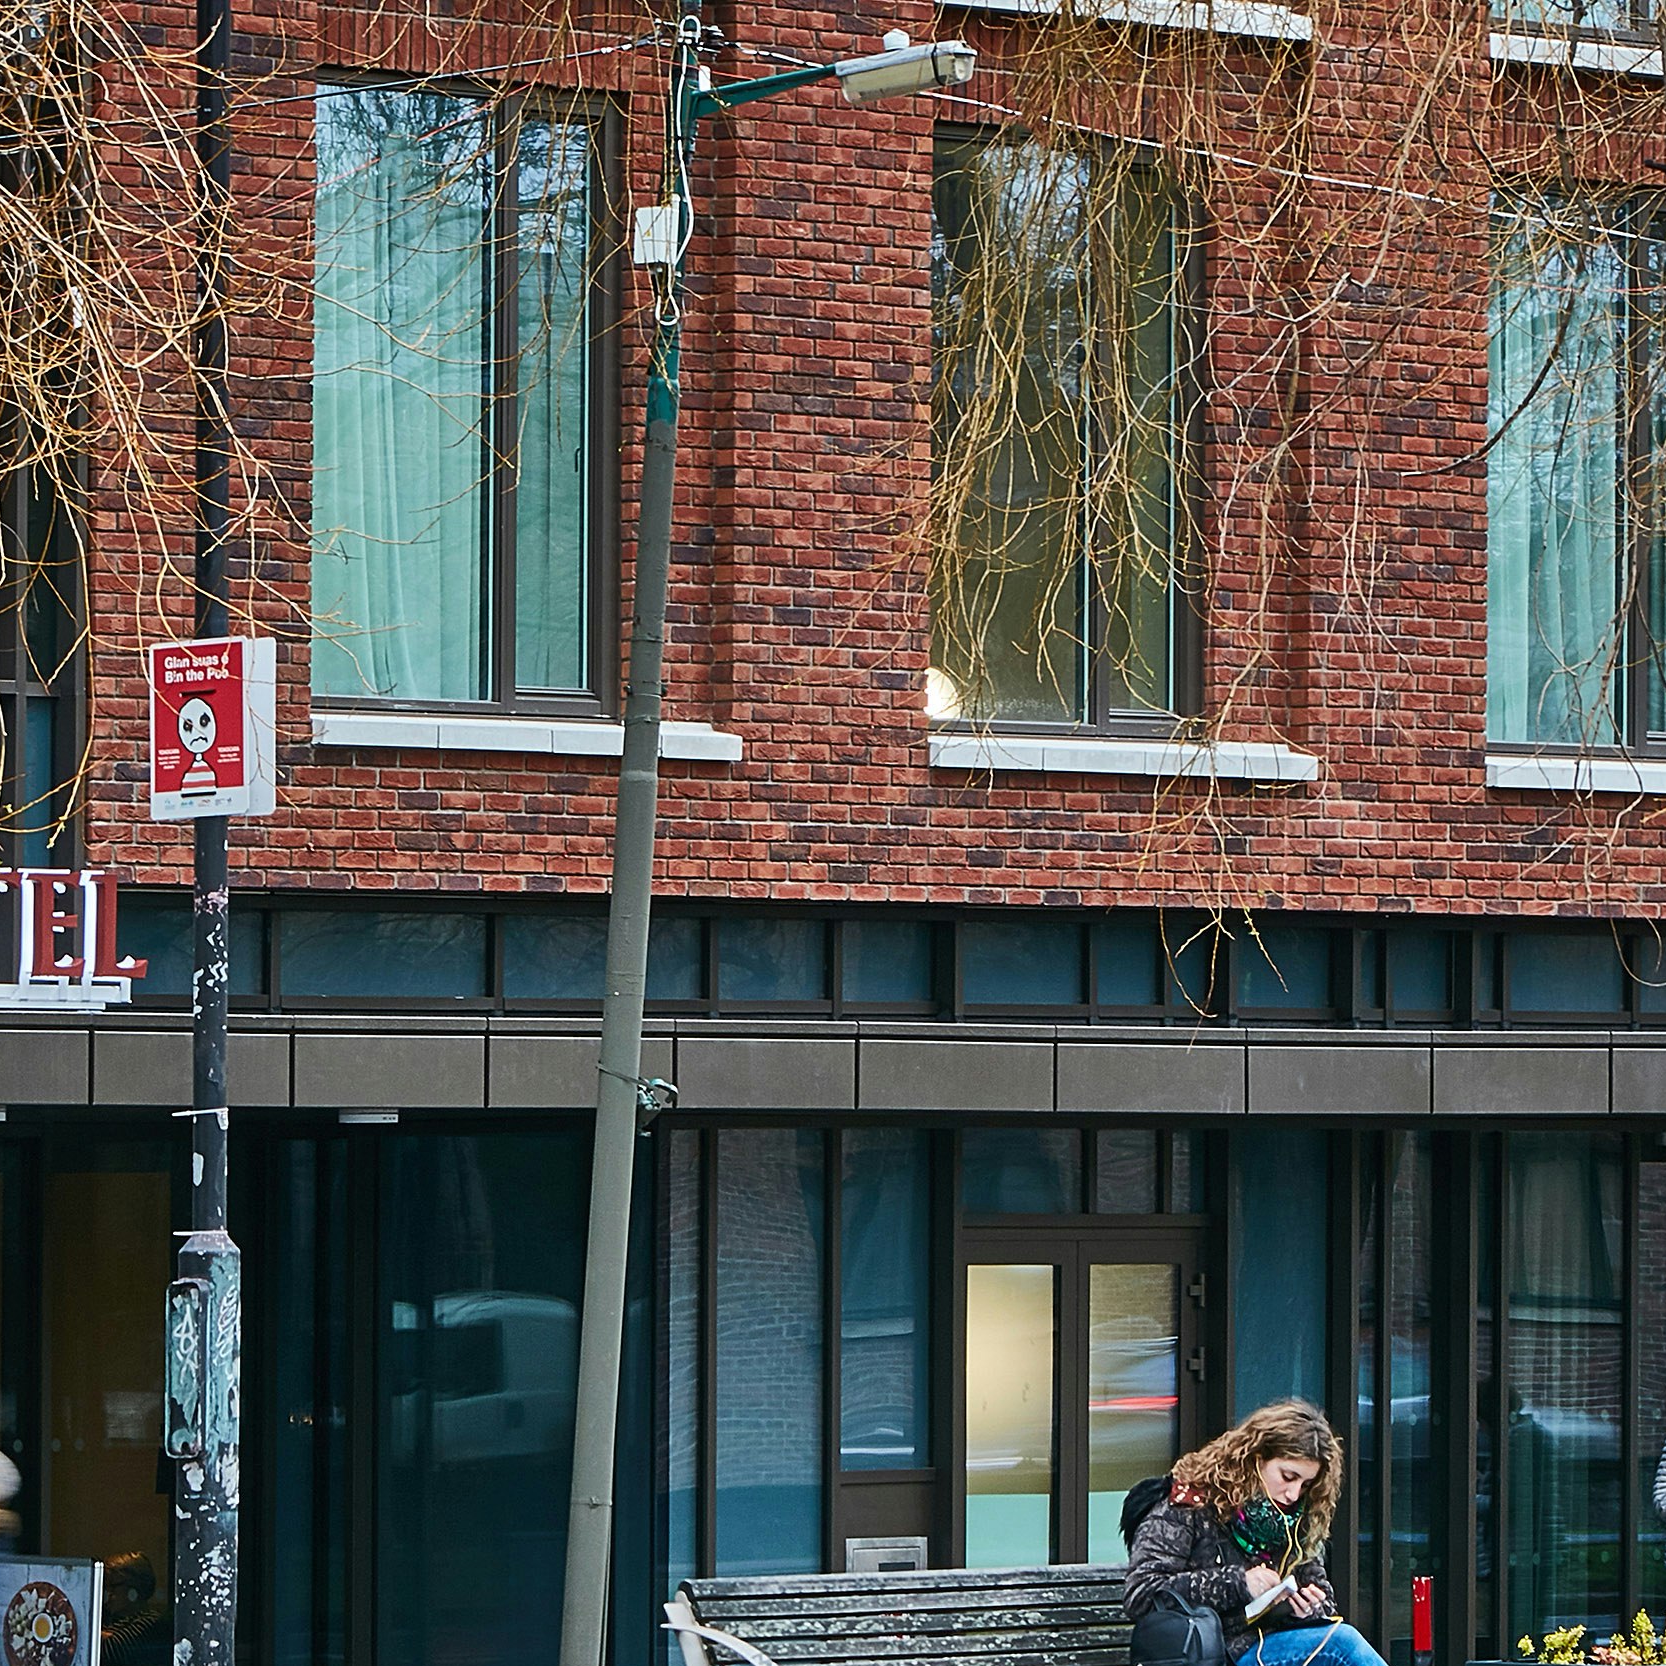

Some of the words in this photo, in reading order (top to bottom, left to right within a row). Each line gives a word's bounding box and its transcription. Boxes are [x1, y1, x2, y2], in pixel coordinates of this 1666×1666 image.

[164, 656, 190, 669] Glan
[191, 654, 219, 668] suas
[164, 670, 183, 684] Bin
[185, 668, 204, 682] the
[207, 667, 229, 681] Poo
